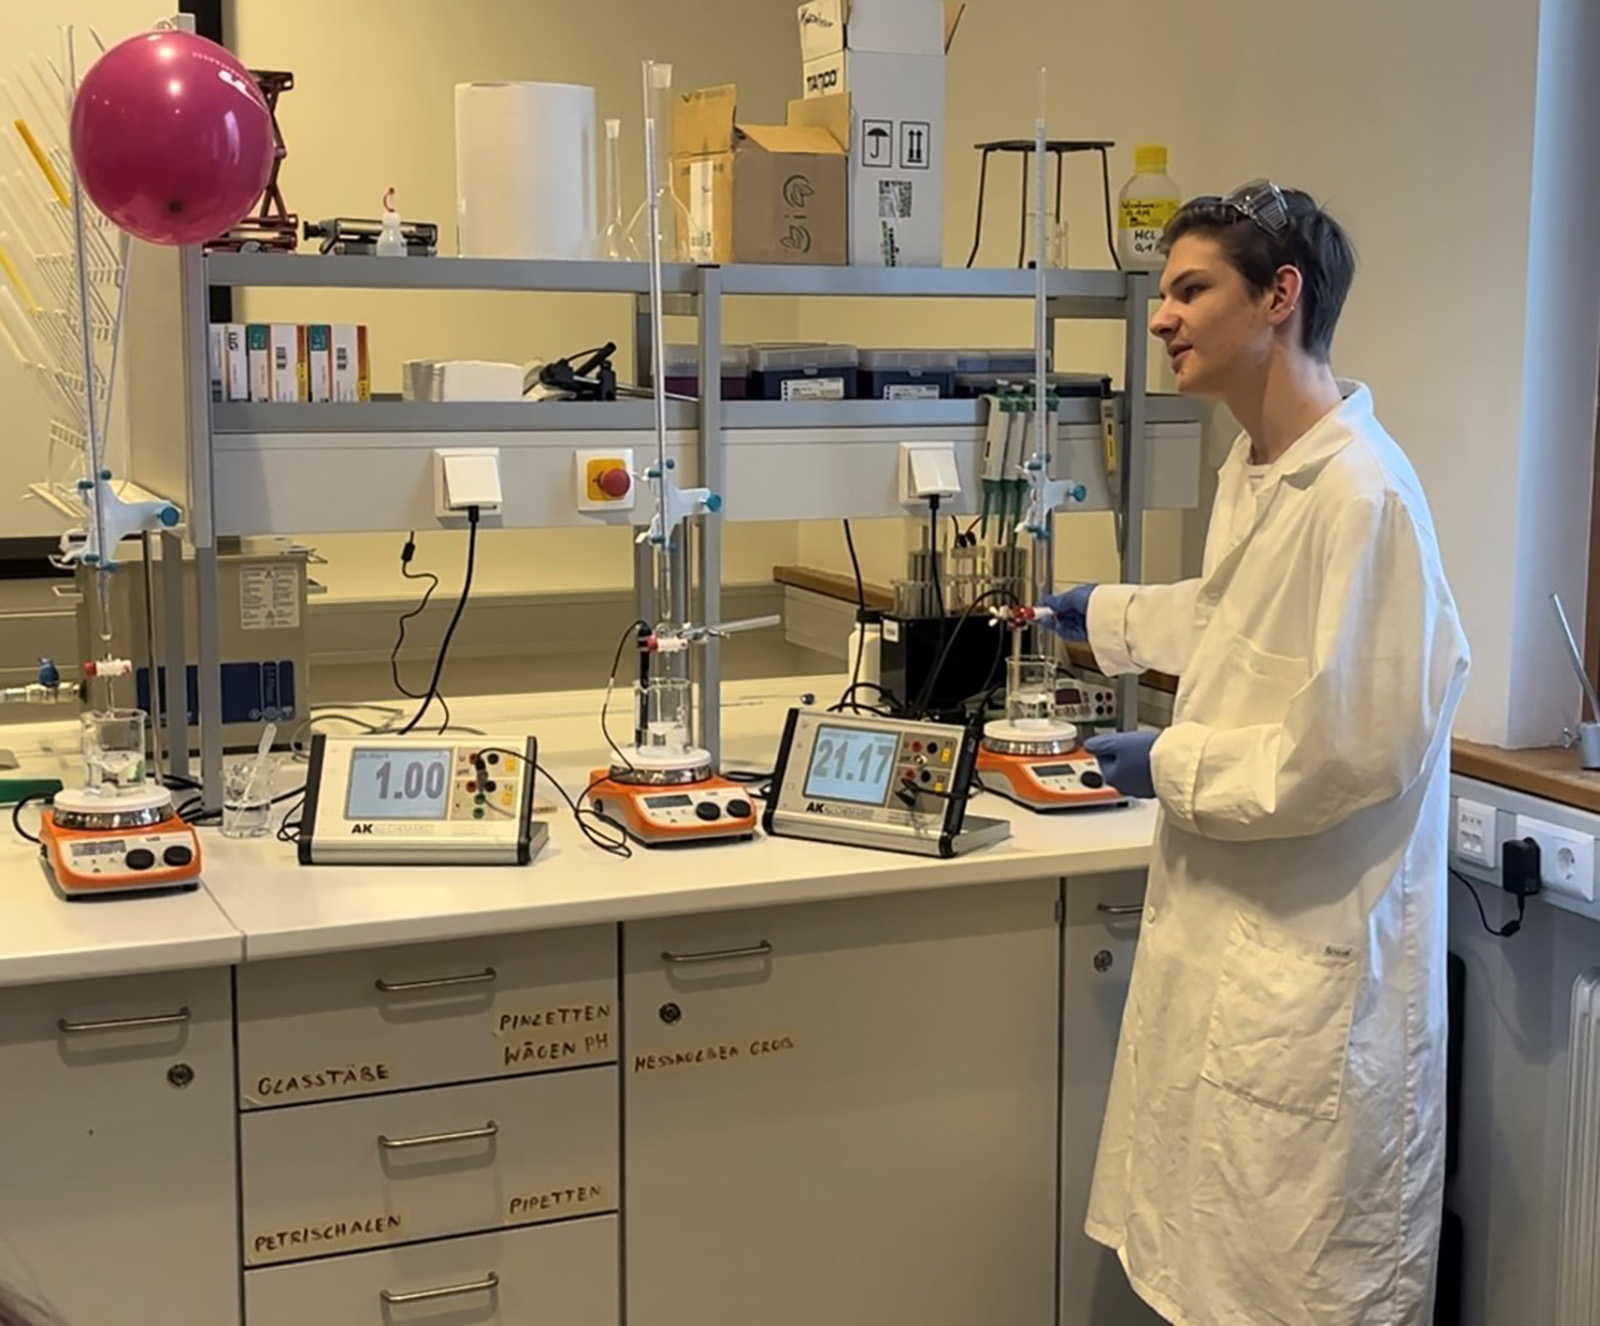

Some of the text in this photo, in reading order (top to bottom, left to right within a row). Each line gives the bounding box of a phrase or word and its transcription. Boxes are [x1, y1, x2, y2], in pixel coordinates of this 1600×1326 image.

[812, 739, 893, 784] 21.17
[375, 761, 445, 799] 1.00
[806, 802, 824, 813] AK
[351, 823, 373, 834] AK
[500, 1004, 610, 1031] PINZETTEN
[258, 1064, 389, 1096] GLASSTÄBE
[509, 1184, 601, 1214] PIPETTEN
[254, 1214, 402, 1252] PETRISCHALEN
